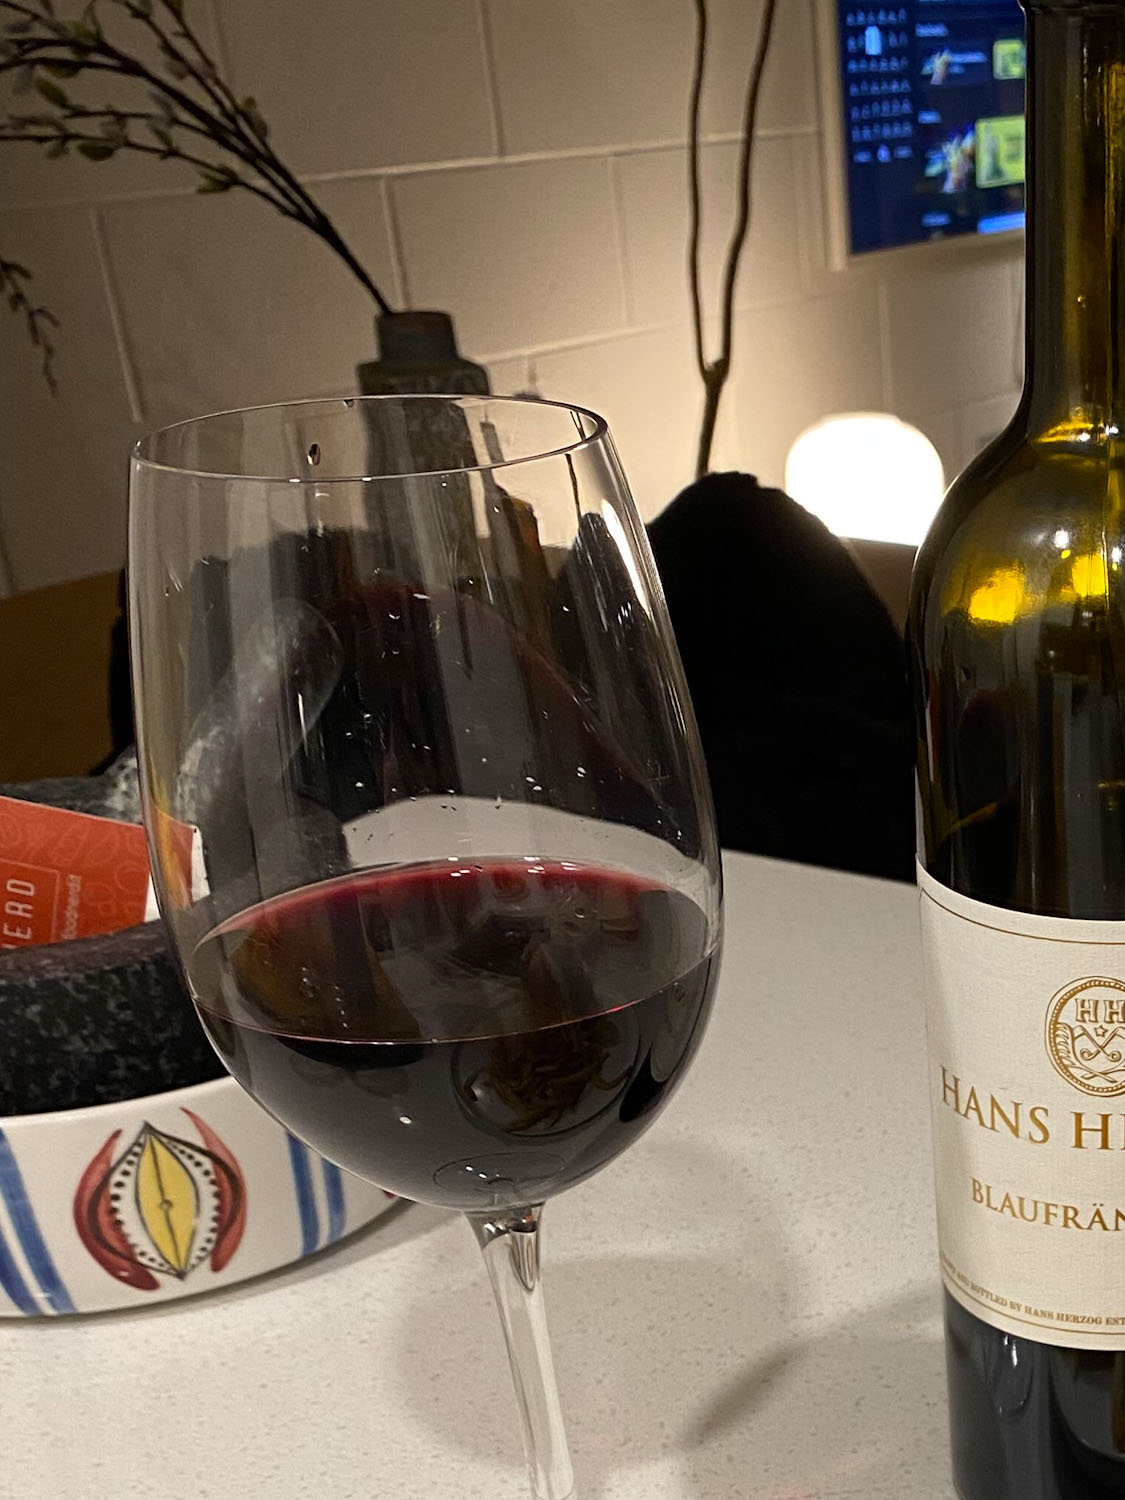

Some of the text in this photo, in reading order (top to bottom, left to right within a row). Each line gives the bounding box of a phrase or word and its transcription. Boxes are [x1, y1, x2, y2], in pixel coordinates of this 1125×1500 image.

[1, 878, 36, 949] ERD
[940, 1065, 1050, 1144] HANS
[1009, 1301, 1022, 1312] BY
[1024, 1305, 1054, 1320] HANS
[1056, 1312, 1102, 1325] HERZOG
